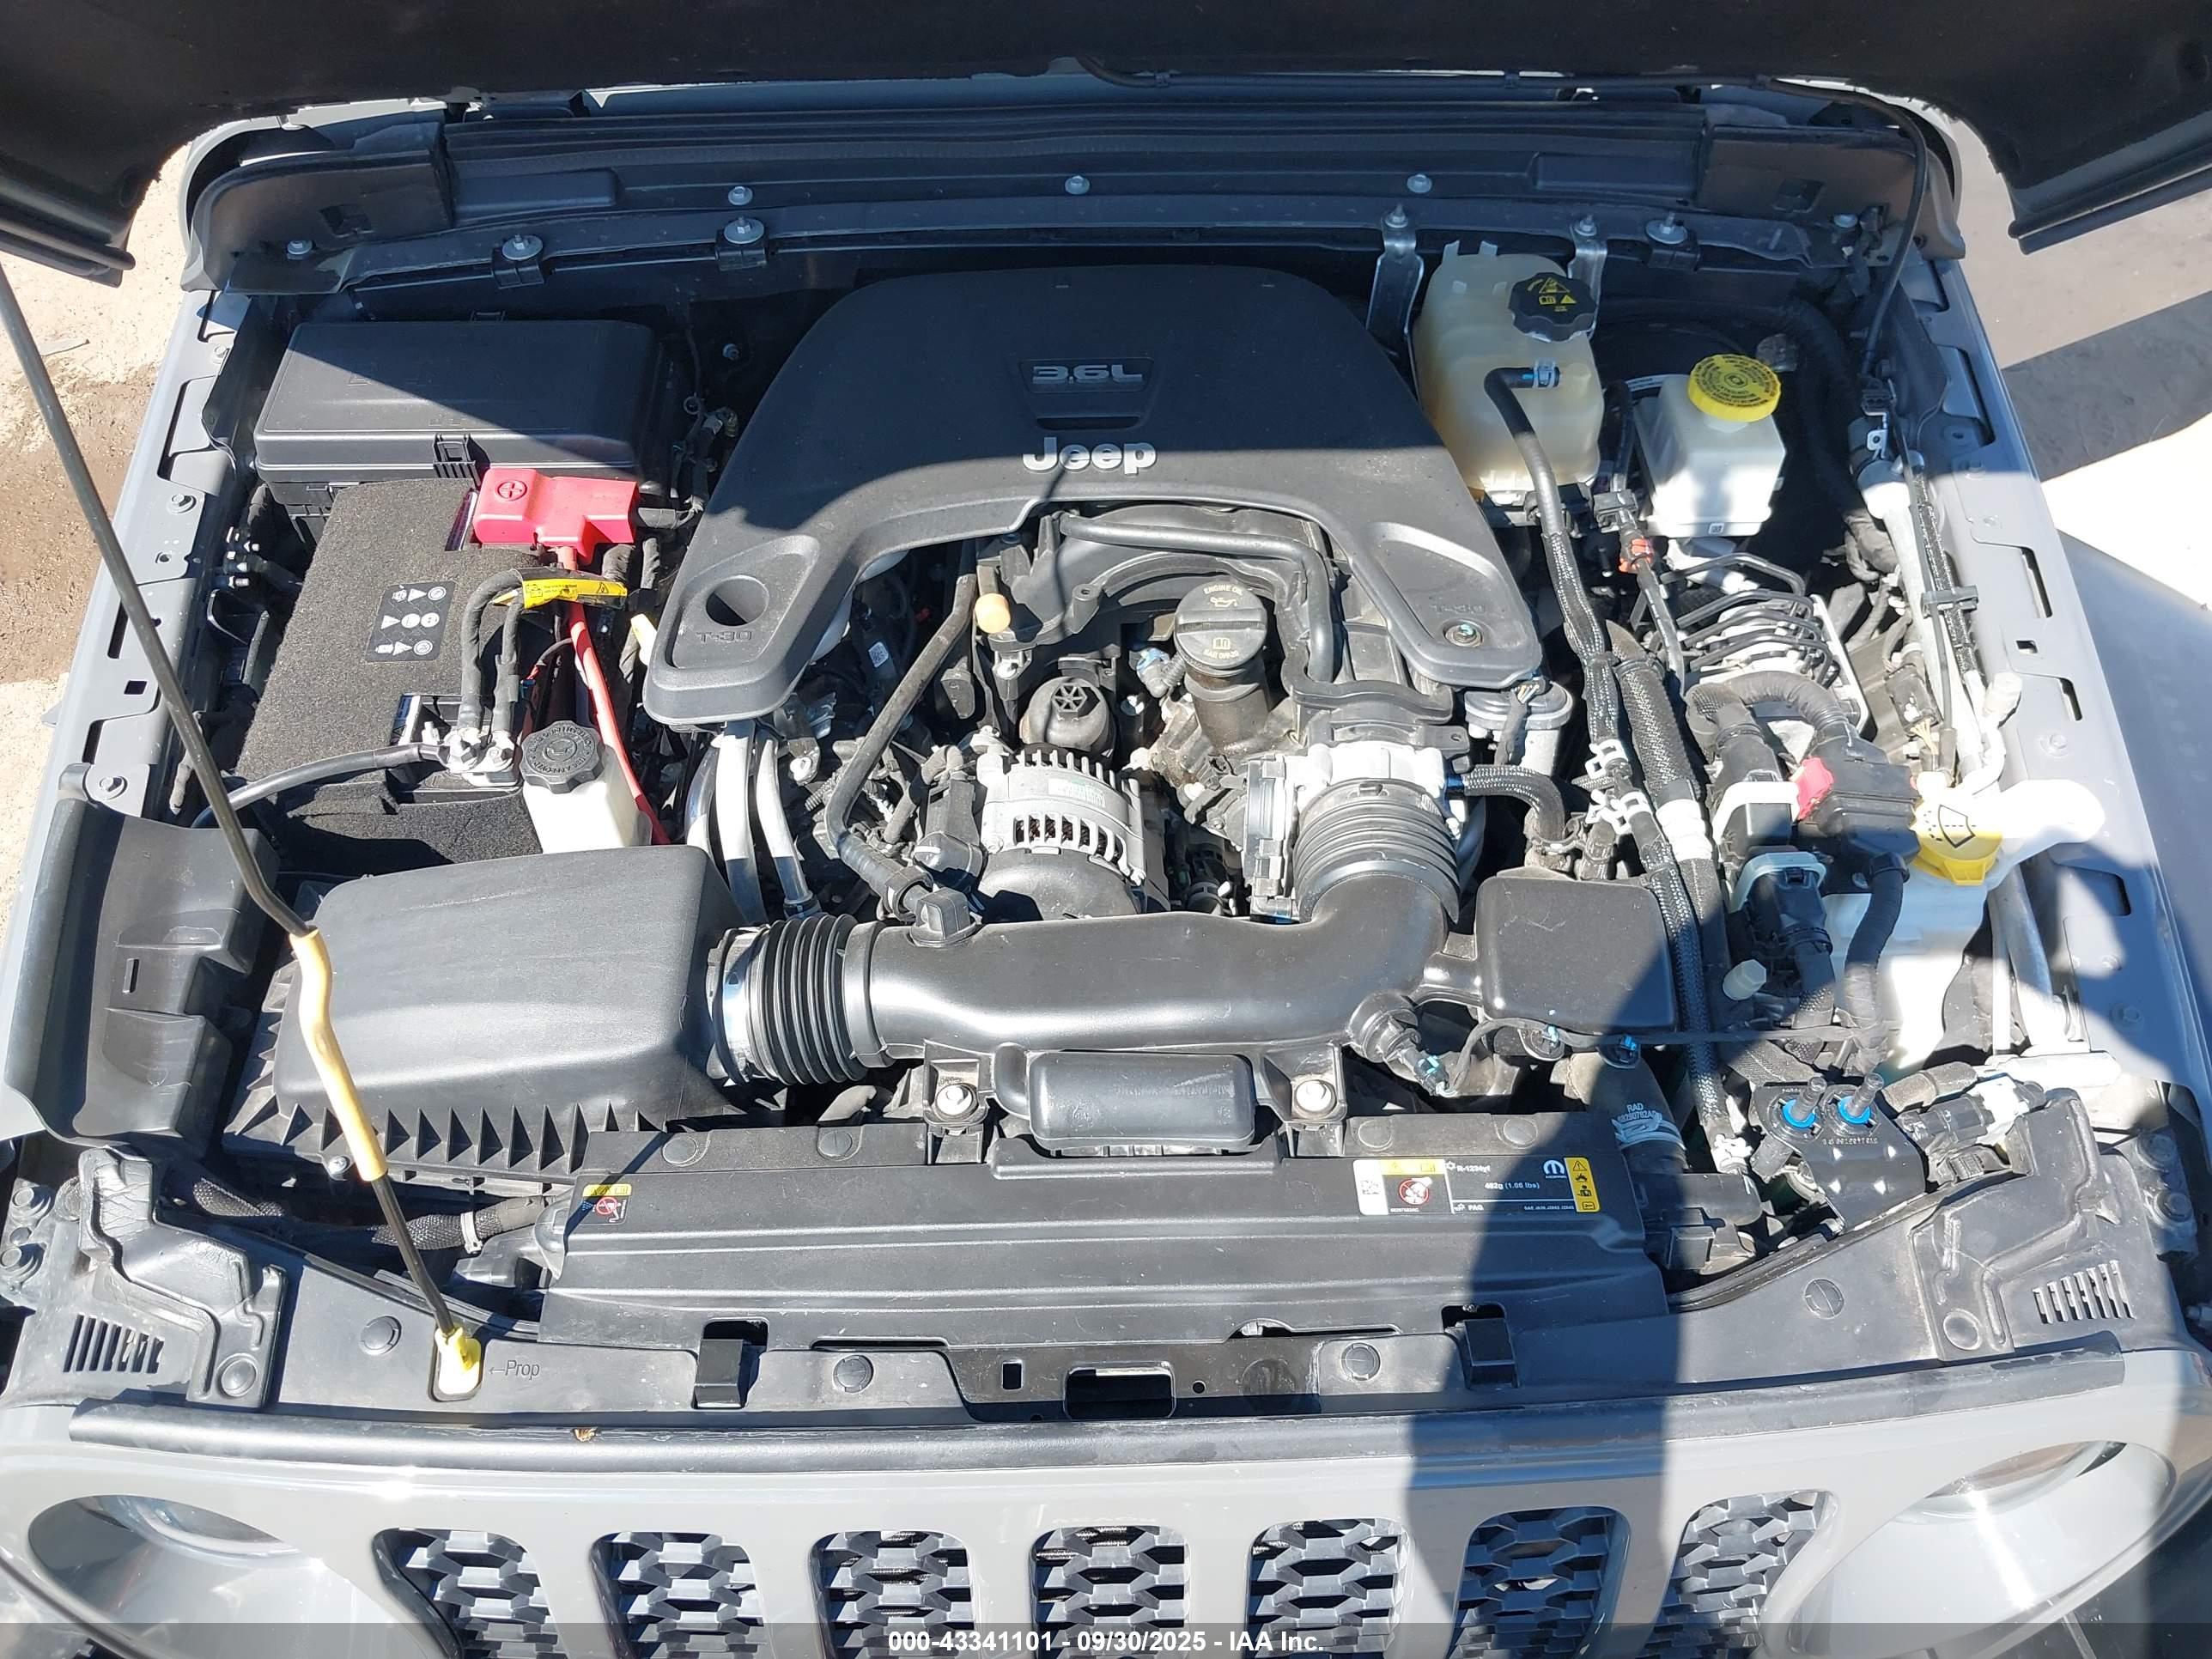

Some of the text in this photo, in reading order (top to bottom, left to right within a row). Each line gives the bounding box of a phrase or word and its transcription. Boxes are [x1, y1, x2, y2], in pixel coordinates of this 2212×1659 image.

[1032, 364, 1143, 384] 3.6L
[1023, 436, 1158, 476] Jeep
[1203, 584, 1232, 594] ENGINE
[1627, 1103, 1644, 1112] RAD
[505, 1359, 540, 1380] Prop
